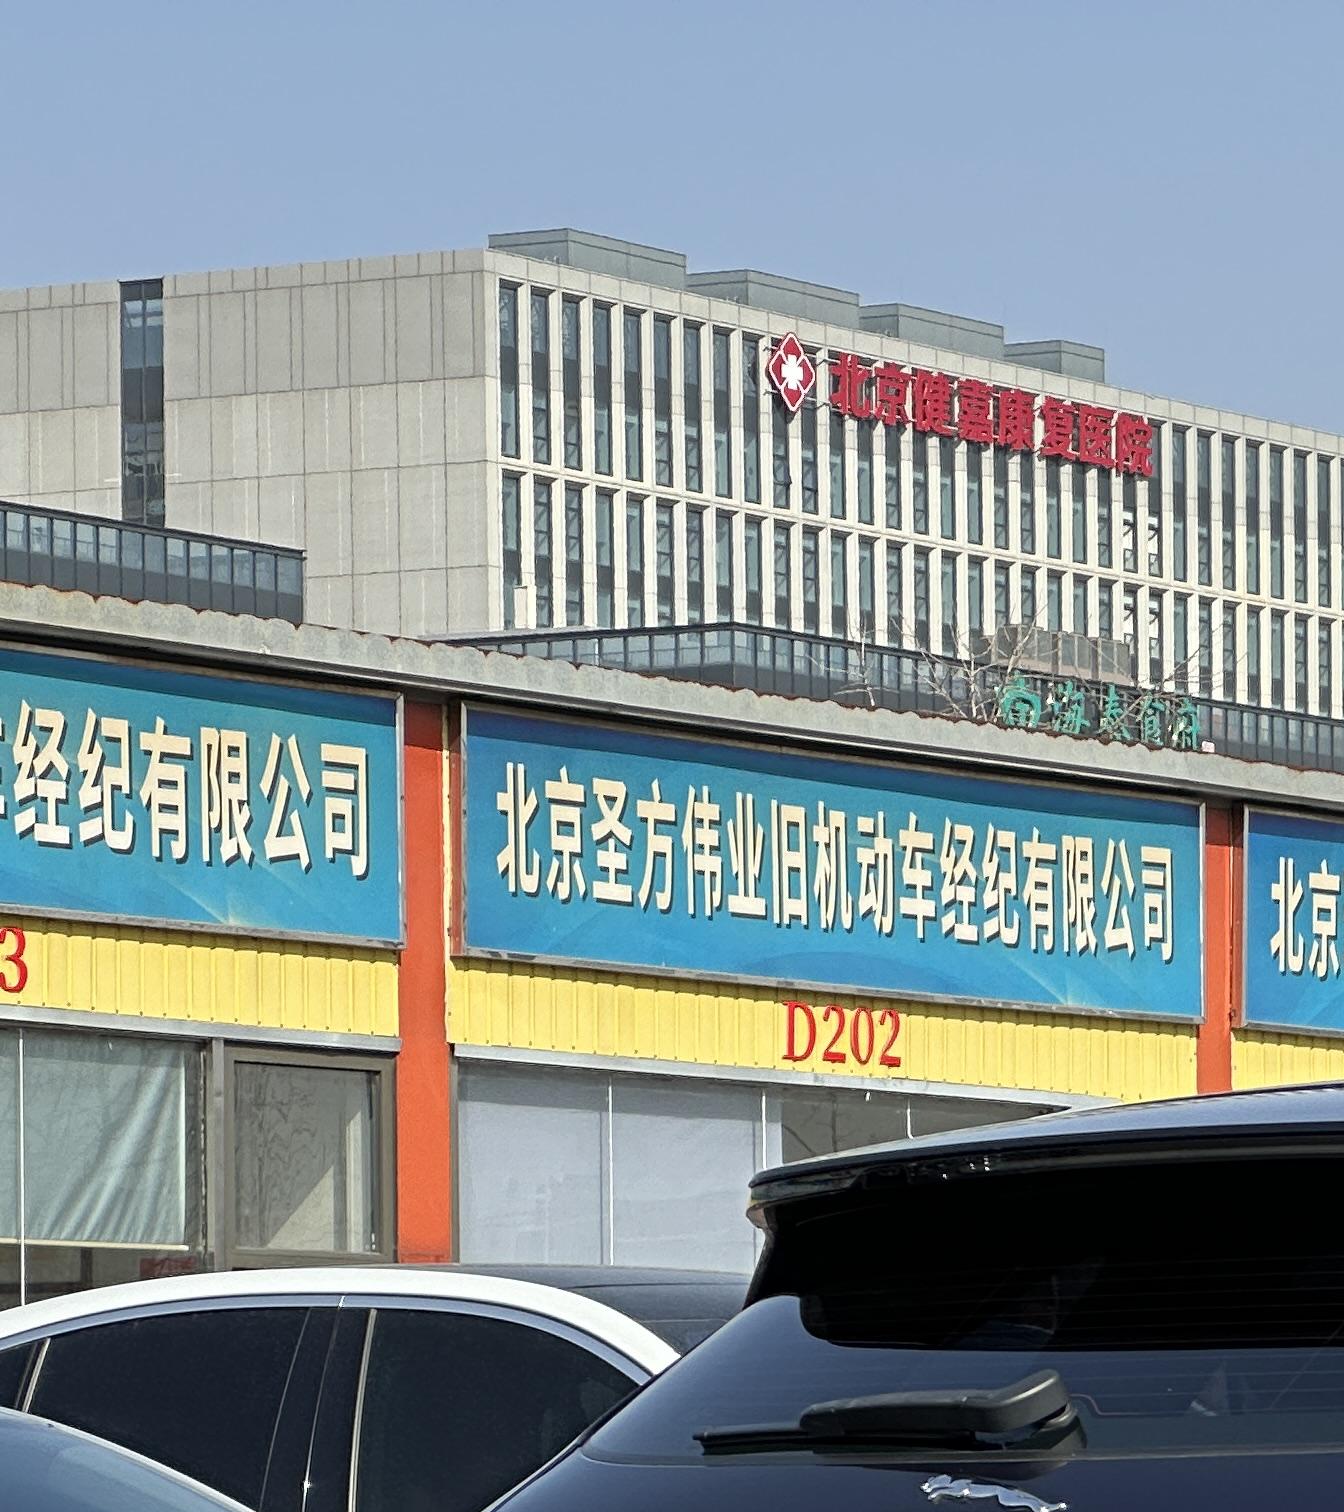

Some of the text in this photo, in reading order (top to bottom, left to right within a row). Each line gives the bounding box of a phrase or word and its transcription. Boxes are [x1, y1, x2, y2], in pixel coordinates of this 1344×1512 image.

[0, 699, 368, 878] 经纪有限公司
[496, 762, 1173, 962] 北京圣方伟业旧机动车经纪有限公司
[0, 927, 28, 993] 3
[782, 1000, 902, 1068] D202
